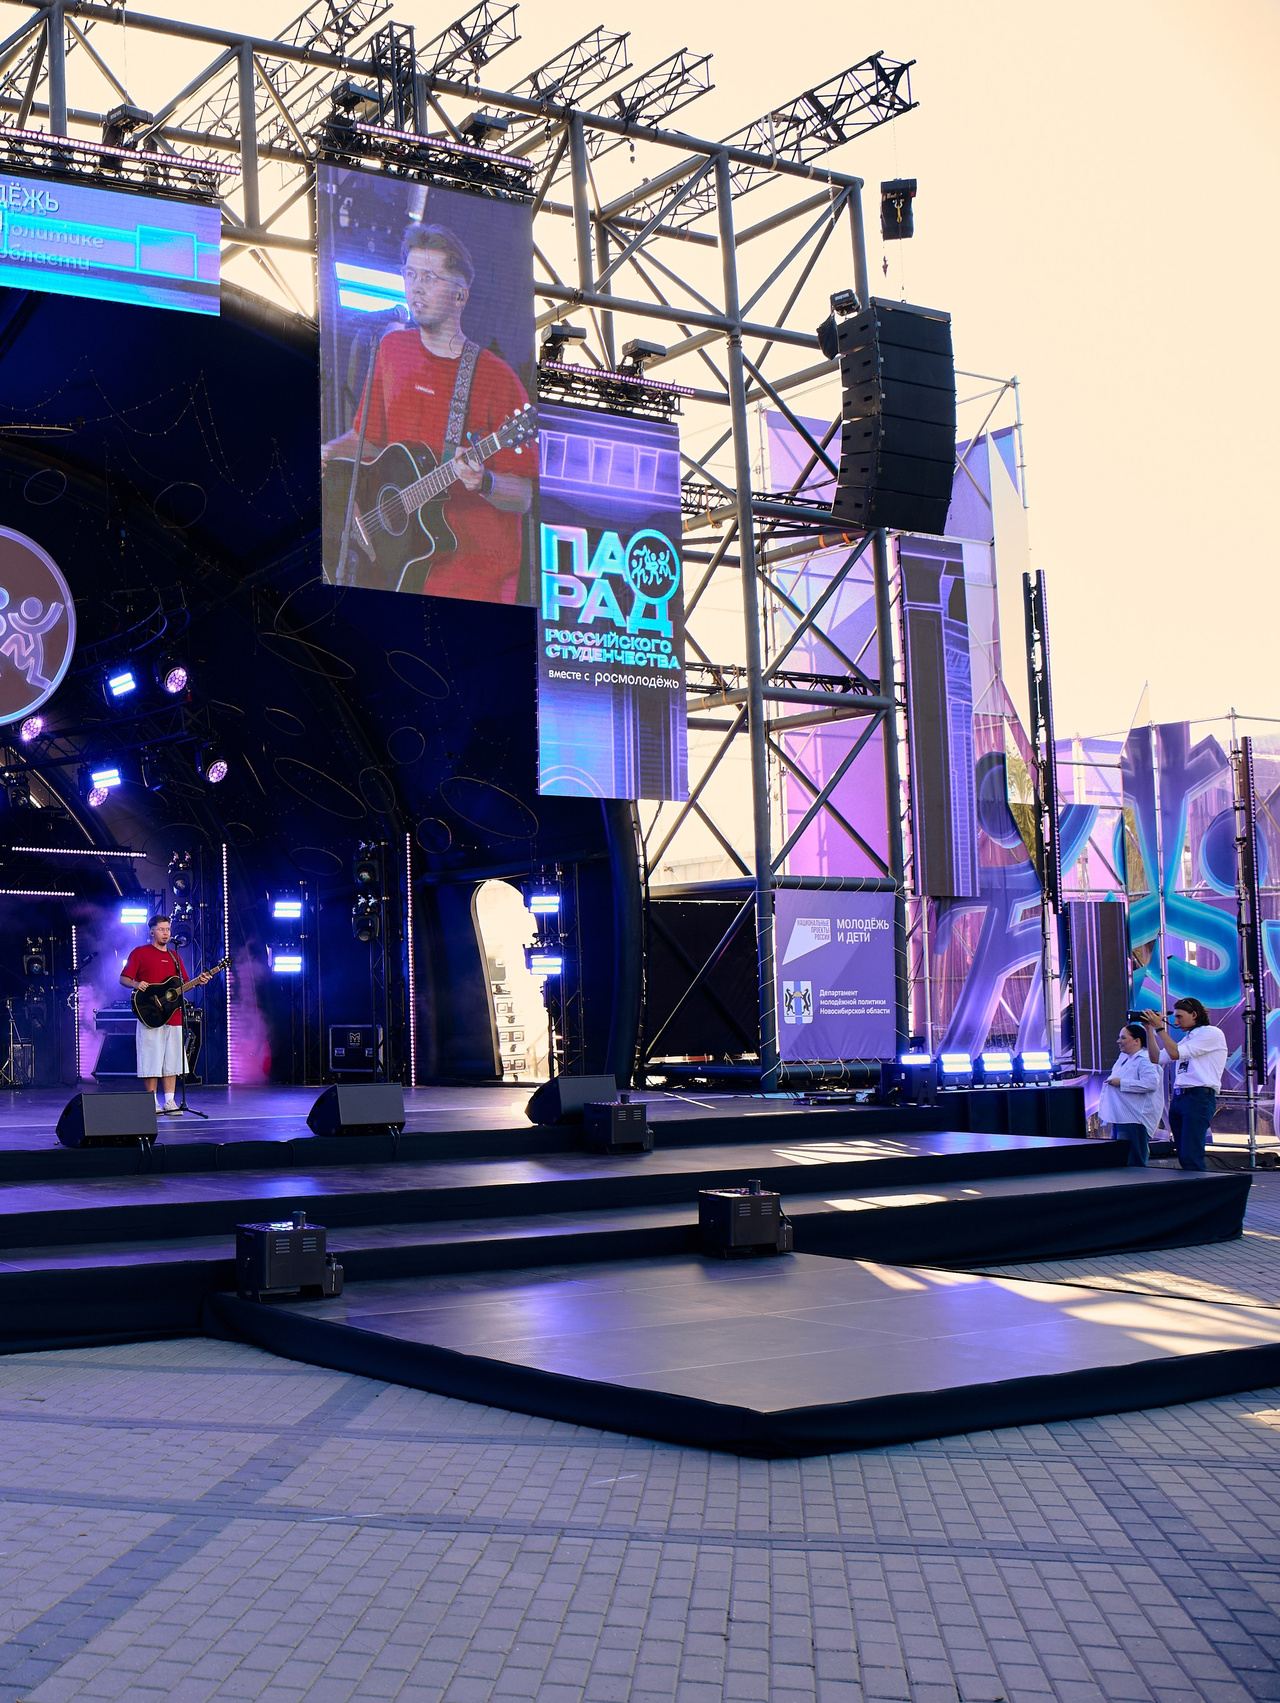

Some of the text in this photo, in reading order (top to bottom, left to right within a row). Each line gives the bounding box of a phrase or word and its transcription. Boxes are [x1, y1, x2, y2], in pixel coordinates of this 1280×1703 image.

[540, 522, 629, 583] ПА
[541, 571, 674, 638] РАД
[545, 628, 672, 654] РОССИЙСКОГО
[545, 644, 681, 670] СТУДЕНЧЕСТВА
[548, 670, 680, 689] вместе с росмолодёжь
[836, 917, 890, 931] МОЛОДЁЖЬ
[837, 932, 871, 944] И ДЕТИ
[819, 989, 858, 998] Департамент
[819, 997, 857, 1006] молодёжной
[819, 1006, 890, 1016] Новосибирской области
